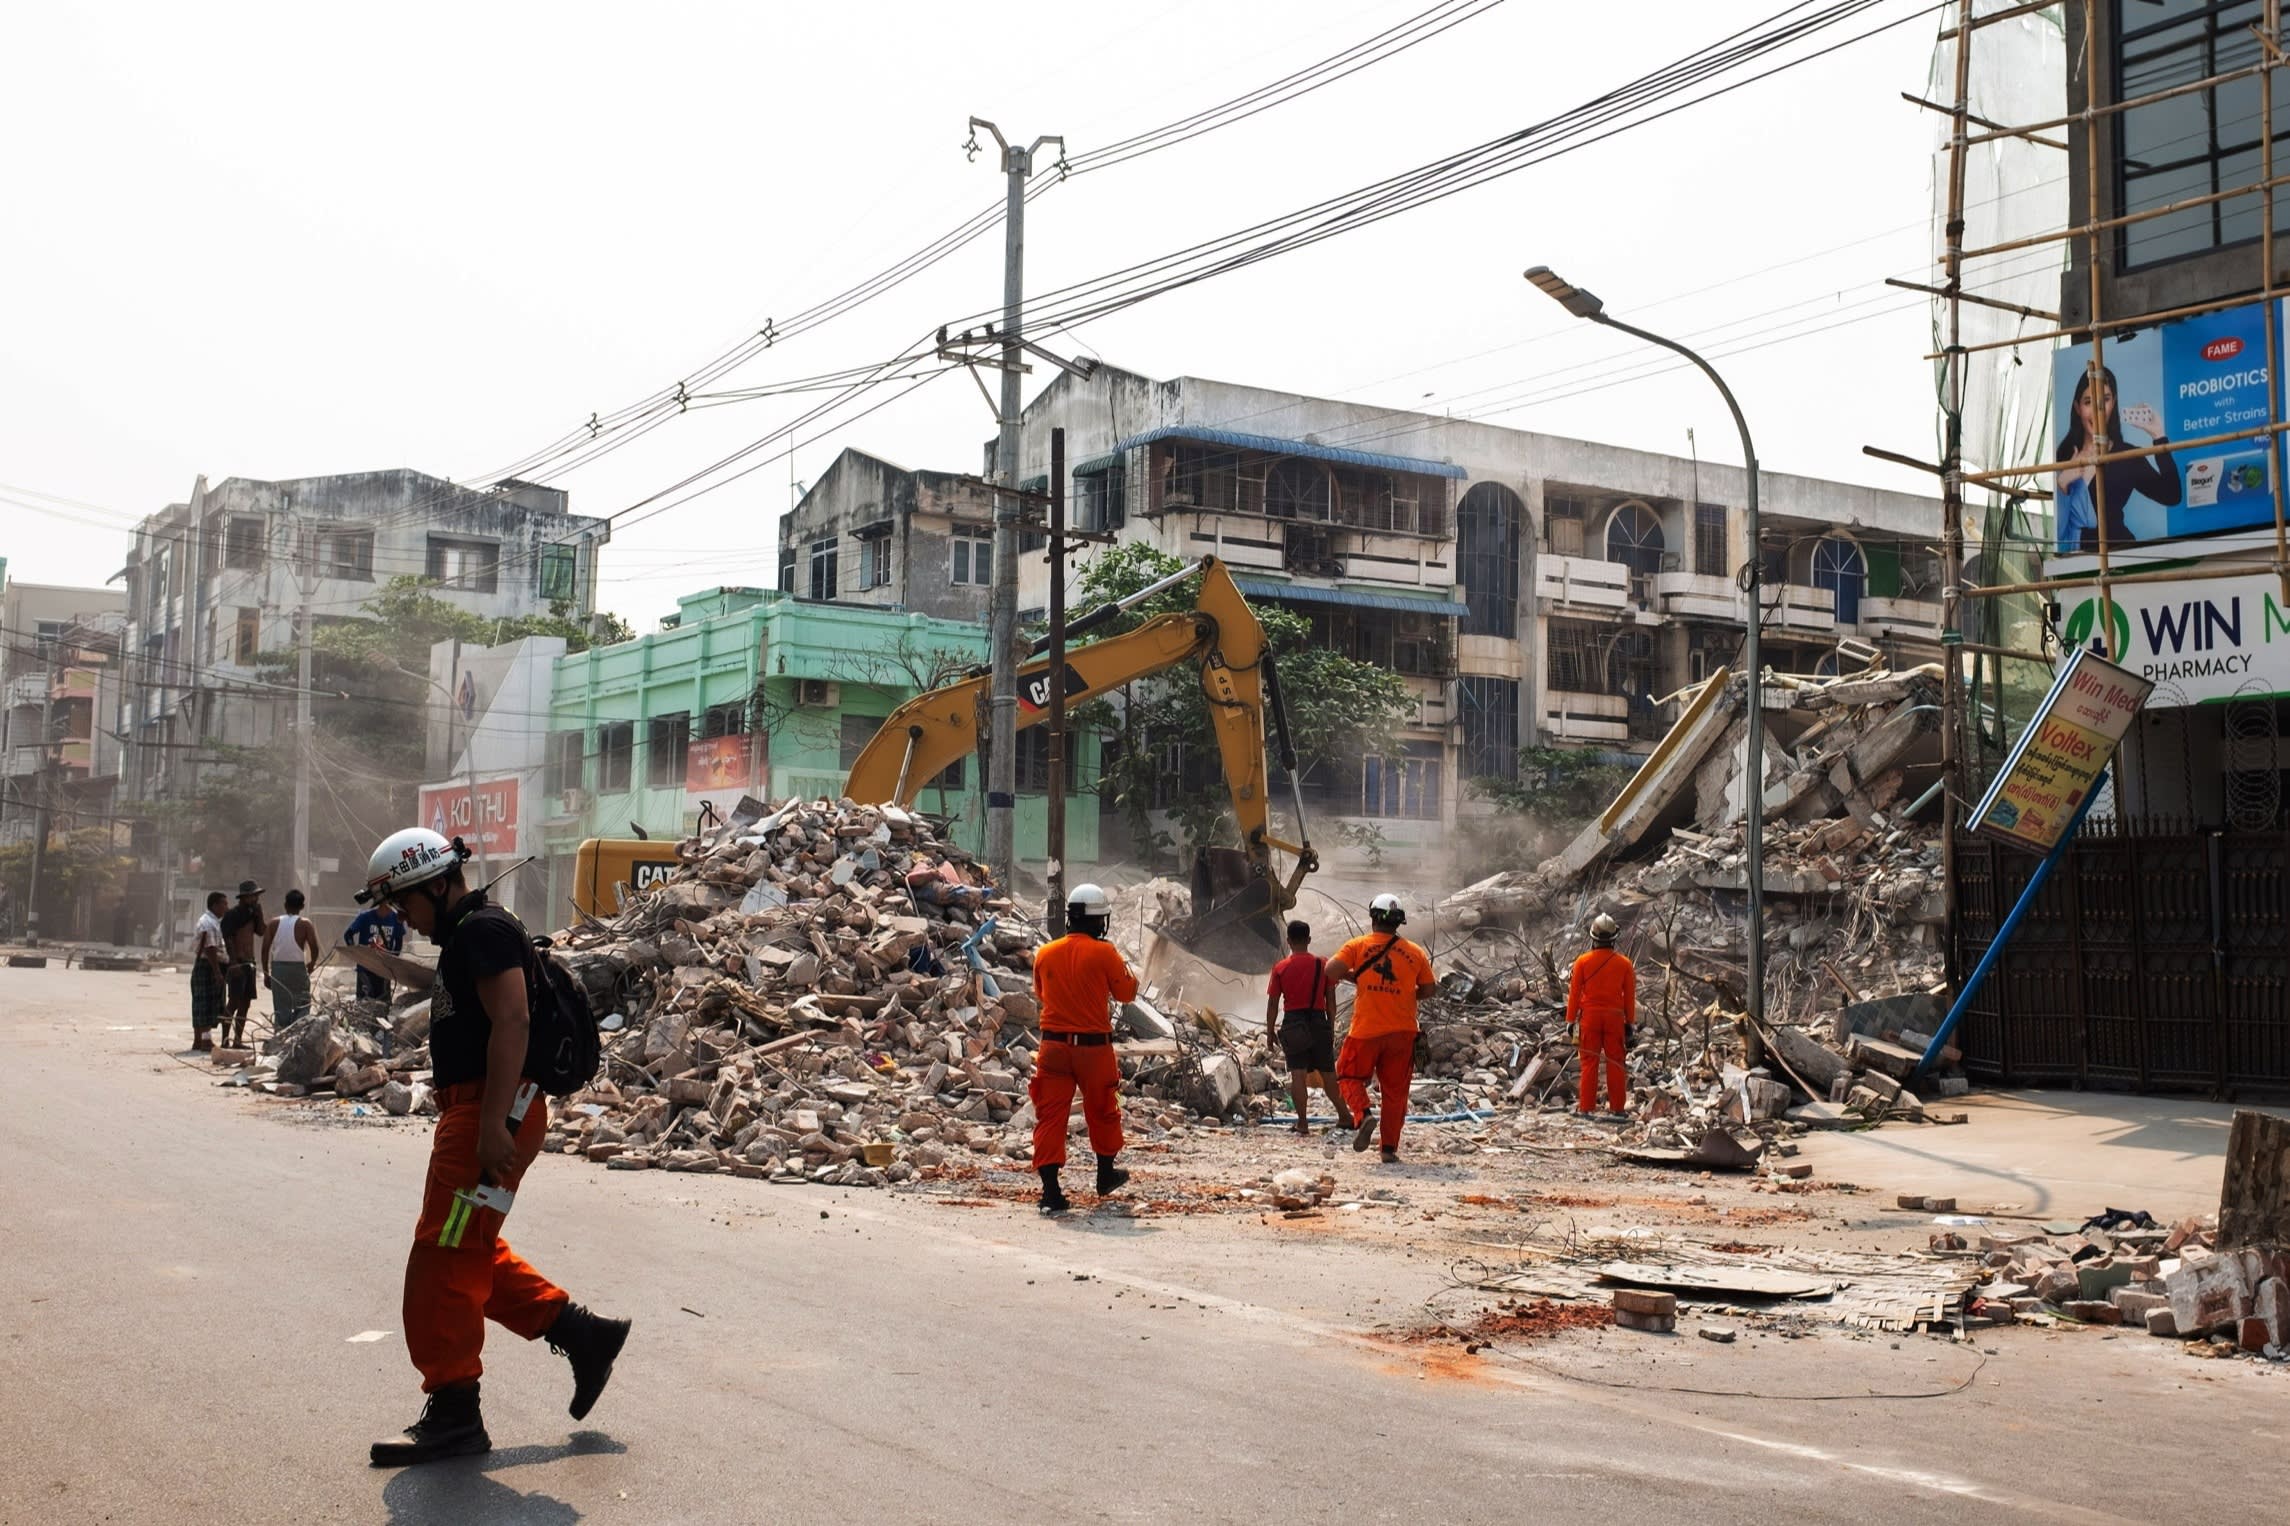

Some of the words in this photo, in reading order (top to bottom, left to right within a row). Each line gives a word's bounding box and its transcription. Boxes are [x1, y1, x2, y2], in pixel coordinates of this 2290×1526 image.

[2207, 341, 2238, 358] FAME
[2180, 367, 2269, 399] PROBIOTICS
[2214, 396, 2235, 408] with
[2183, 415, 2220, 431] Better
[2224, 407, 2267, 424] Strains
[2140, 596, 2241, 656] WIN
[2143, 653, 2252, 681] PHARMACY
[2073, 670, 2103, 698] Win
[2103, 684, 2141, 713] Med
[2040, 721, 2096, 760] Voltex
[637, 865, 675, 889] CAT
